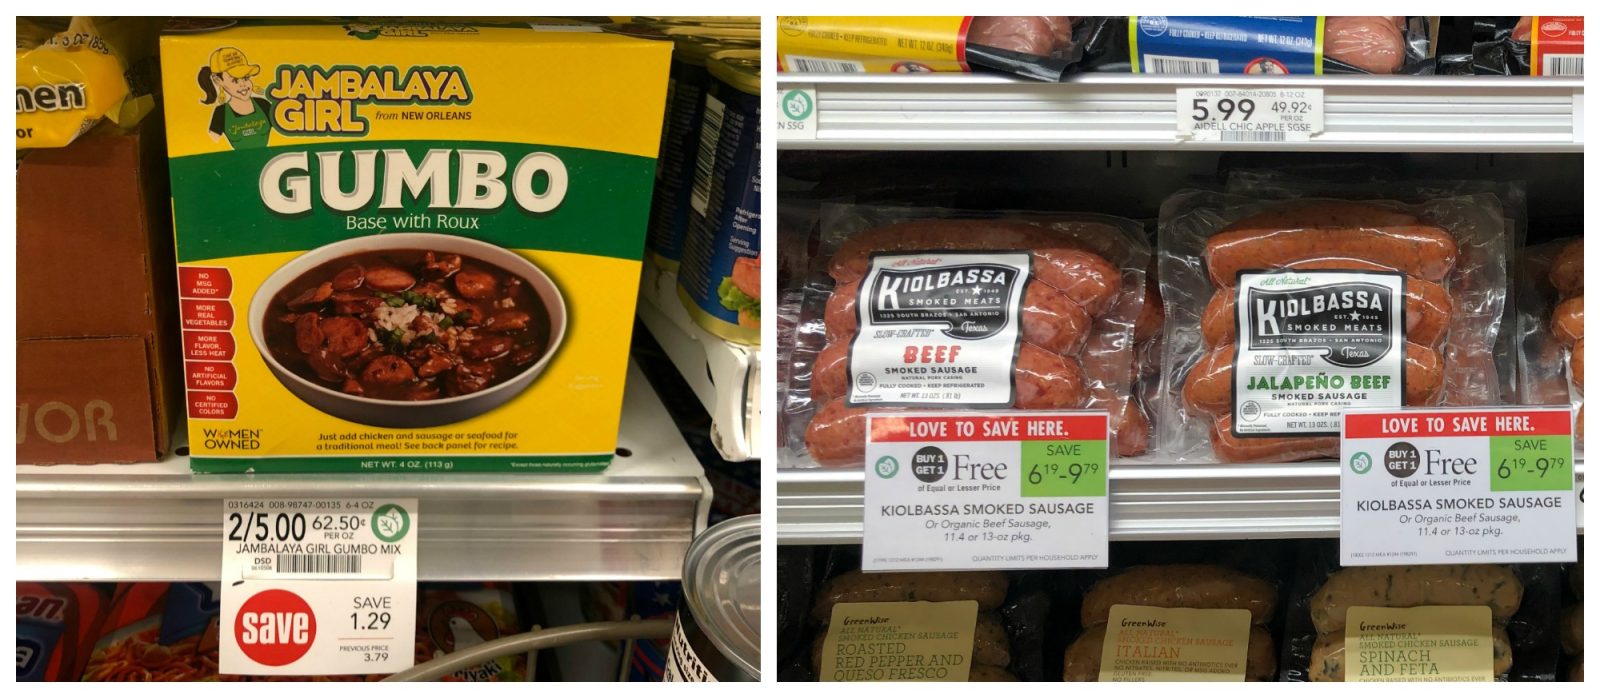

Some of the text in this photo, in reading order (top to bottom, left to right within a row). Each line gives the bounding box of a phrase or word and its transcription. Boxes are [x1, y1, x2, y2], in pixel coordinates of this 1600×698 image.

[268, 67, 471, 102] JAMBALAYA
[272, 98, 367, 134] GIRL
[375, 110, 472, 121] from NEW ORLEANS
[1192, 98, 1312, 122] 5.99 49.92¢
[1194, 122, 1312, 132] AIDELL CHIC APPLE SGSE
[258, 148, 569, 214] GUMBO
[346, 213, 480, 230] Base with Roux
[878, 269, 1006, 311] KIOLBASSA
[908, 297, 1001, 306] SMOKED MEATS
[196, 304, 216, 312] MORE
[1256, 291, 1383, 336] KIOLBASSA
[185, 319, 228, 327] VEGETABLES
[961, 321, 989, 333] Texas
[1287, 323, 1383, 332] SMOKED MEATS
[197, 335, 217, 343] MORE
[903, 345, 962, 364] BEEF
[1341, 346, 1370, 359] Texas
[204, 365, 215, 373] NO
[884, 366, 978, 375] SMOKED SAUSAGE
[196, 379, 225, 387] FLAVORS
[1247, 372, 1391, 390] JALAPEÑO BEEF
[1271, 393, 1314, 401] SMOKED
[909, 420, 1069, 438] LOVE TO SAVE HERE.
[1381, 416, 1536, 433] LOVE TO SAVE HERE.
[318, 431, 518, 441] Just add chicken and sausage or seafood for
[204, 439, 260, 450] OWNED
[324, 442, 374, 450] traditional
[376, 442, 402, 450] meal!
[404, 441, 420, 449] See
[422, 441, 443, 449] back
[445, 442, 471, 450] panel
[474, 441, 487, 450] for
[489, 441, 518, 450] recipe.
[1046, 444, 1081, 456] SAVE
[1514, 439, 1547, 451] SAVE
[915, 454, 945, 463] BUY 1
[1389, 450, 1417, 459] BUY 1
[361, 461, 380, 469] NET
[381, 461, 397, 469] WT.
[399, 461, 405, 469] 4
[424, 461, 443, 469] (113
[444, 461, 454, 469] g)
[952, 454, 1008, 481] Free
[1389, 461, 1417, 470] GET 1
[1424, 449, 1477, 476] Free
[915, 466, 945, 475] GET 1
[917, 484, 926, 492] of
[926, 484, 946, 493] Equal
[957, 484, 980, 492] Lesser
[981, 484, 1001, 492] Price
[228, 501, 375, 509] 0316424 008-98747-00135 6-4 OZ
[881, 502, 1095, 516] KIOLBASSA SMOKED SAUSAGE
[1357, 497, 1562, 511] KIOLBASSA SMOKED SAUSAGE
[228, 511, 367, 542] 2/5.00 62.50¢
[925, 518, 1051, 531] Or Organic Beef Sausage,
[324, 532, 355, 540] PER OZ
[944, 532, 1033, 543] 11.4 or 13-oz pkg.
[235, 543, 402, 555] JAMBALAYA GIRL GUMBO MIX
[254, 557, 272, 565] DSD
[353, 596, 391, 609] SAVE
[350, 612, 391, 630] 1.29
[843, 616, 890, 626] GreenWise
[1121, 617, 1168, 628] GreenWise
[241, 611, 309, 645] save
[836, 642, 906, 656] ROASTED
[1115, 645, 1181, 659] ITALIAN
[364, 653, 389, 662] 3.79
[835, 654, 964, 669] RED PEPPER AND
[1359, 650, 1431, 663] SPINACH
[834, 667, 948, 682] QUESO FRESCO
[1359, 662, 1440, 676] AND FETA
